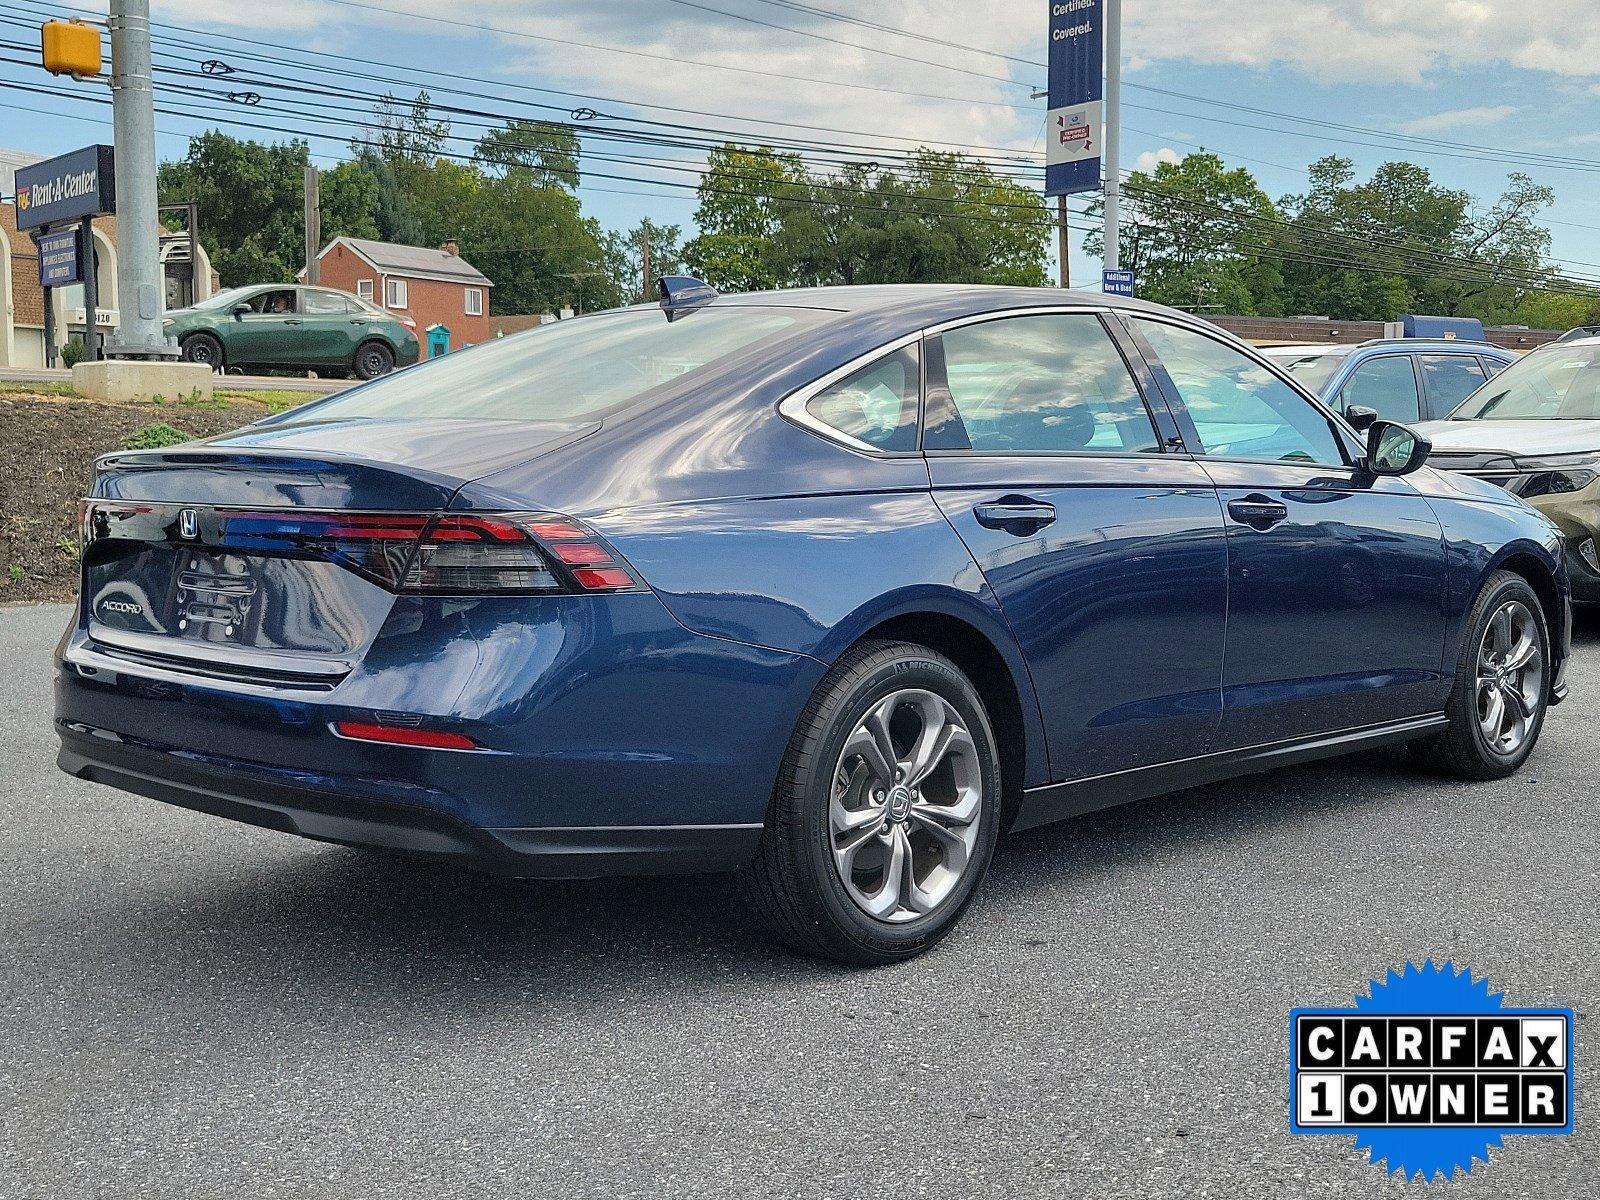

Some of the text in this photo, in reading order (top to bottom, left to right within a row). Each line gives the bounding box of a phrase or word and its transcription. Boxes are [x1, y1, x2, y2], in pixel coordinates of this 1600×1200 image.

[1053, 0, 1095, 16] Certified.
[1053, 21, 1092, 41] Covered.
[96, 314, 110, 323] 120
[101, 600, 142, 614] ACCORD
